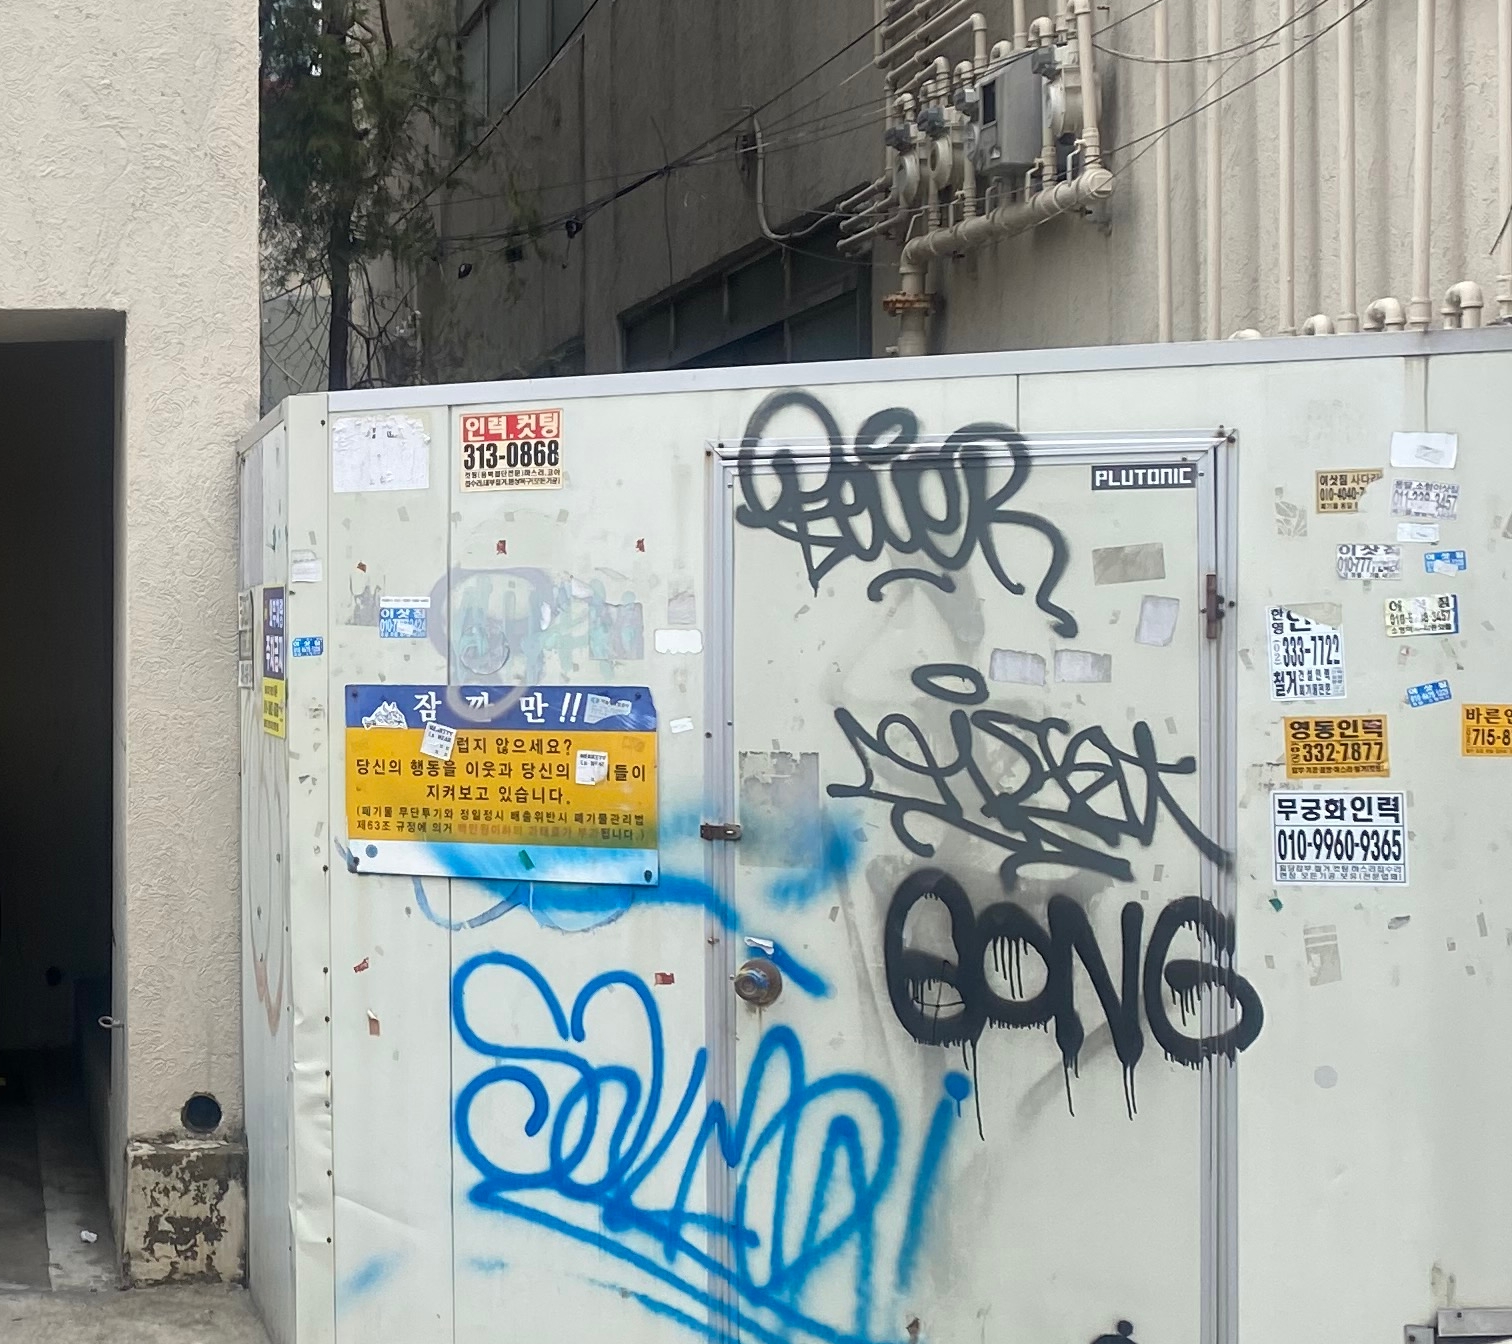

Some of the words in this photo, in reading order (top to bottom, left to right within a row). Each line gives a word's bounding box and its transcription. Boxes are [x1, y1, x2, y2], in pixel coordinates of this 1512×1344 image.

[463, 439, 560, 471] 313-0868
[1095, 467, 1192, 487] PLUTONIC
[1320, 474, 1348, 486] 이삿짐
[1283, 634, 1341, 668] 333-7722
[495, 737, 573, 756] 않으세요?
[1302, 742, 1384, 762] 332-7877
[356, 758, 403, 776] 당신의
[410, 759, 457, 778] 행동을
[465, 760, 513, 779] 이웃과
[521, 762, 570, 781] 당신의
[426, 783, 490, 802] 지켜보고
[498, 785, 571, 806] 있습니다.
[398, 807, 454, 820] 무단투기와
[1276, 795, 1401, 824] 무궁화인력
[356, 819, 392, 832] 제63조
[395, 821, 428, 833] 규정에
[432, 822, 453, 834] 의거
[1277, 827, 1402, 862] 010-9960-9365
